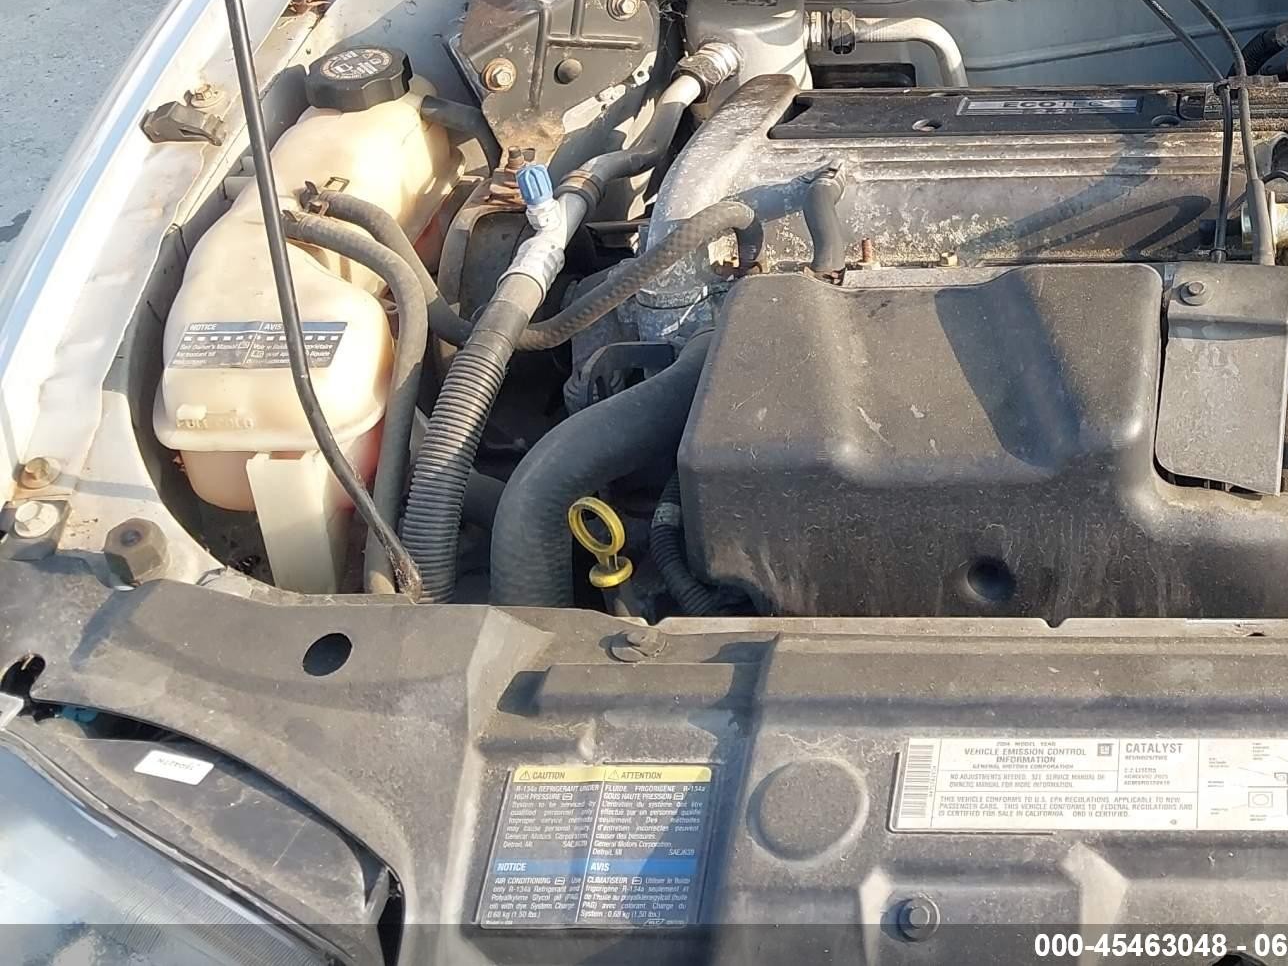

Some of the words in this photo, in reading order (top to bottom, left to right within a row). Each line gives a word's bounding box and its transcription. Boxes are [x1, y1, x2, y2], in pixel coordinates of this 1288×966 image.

[189, 323, 217, 331] NOTICE
[264, 323, 283, 331] AVIS
[964, 748, 1000, 756] VEHICLE
[1002, 748, 1044, 756] EMISSION
[1047, 748, 1087, 756] CONTROL
[1125, 743, 1183, 754] CATALYST
[532, 771, 566, 780] CAUTION
[620, 771, 663, 780] ATTENTION
[496, 862, 528, 872] NOTICE
[590, 862, 611, 872] AVIS
